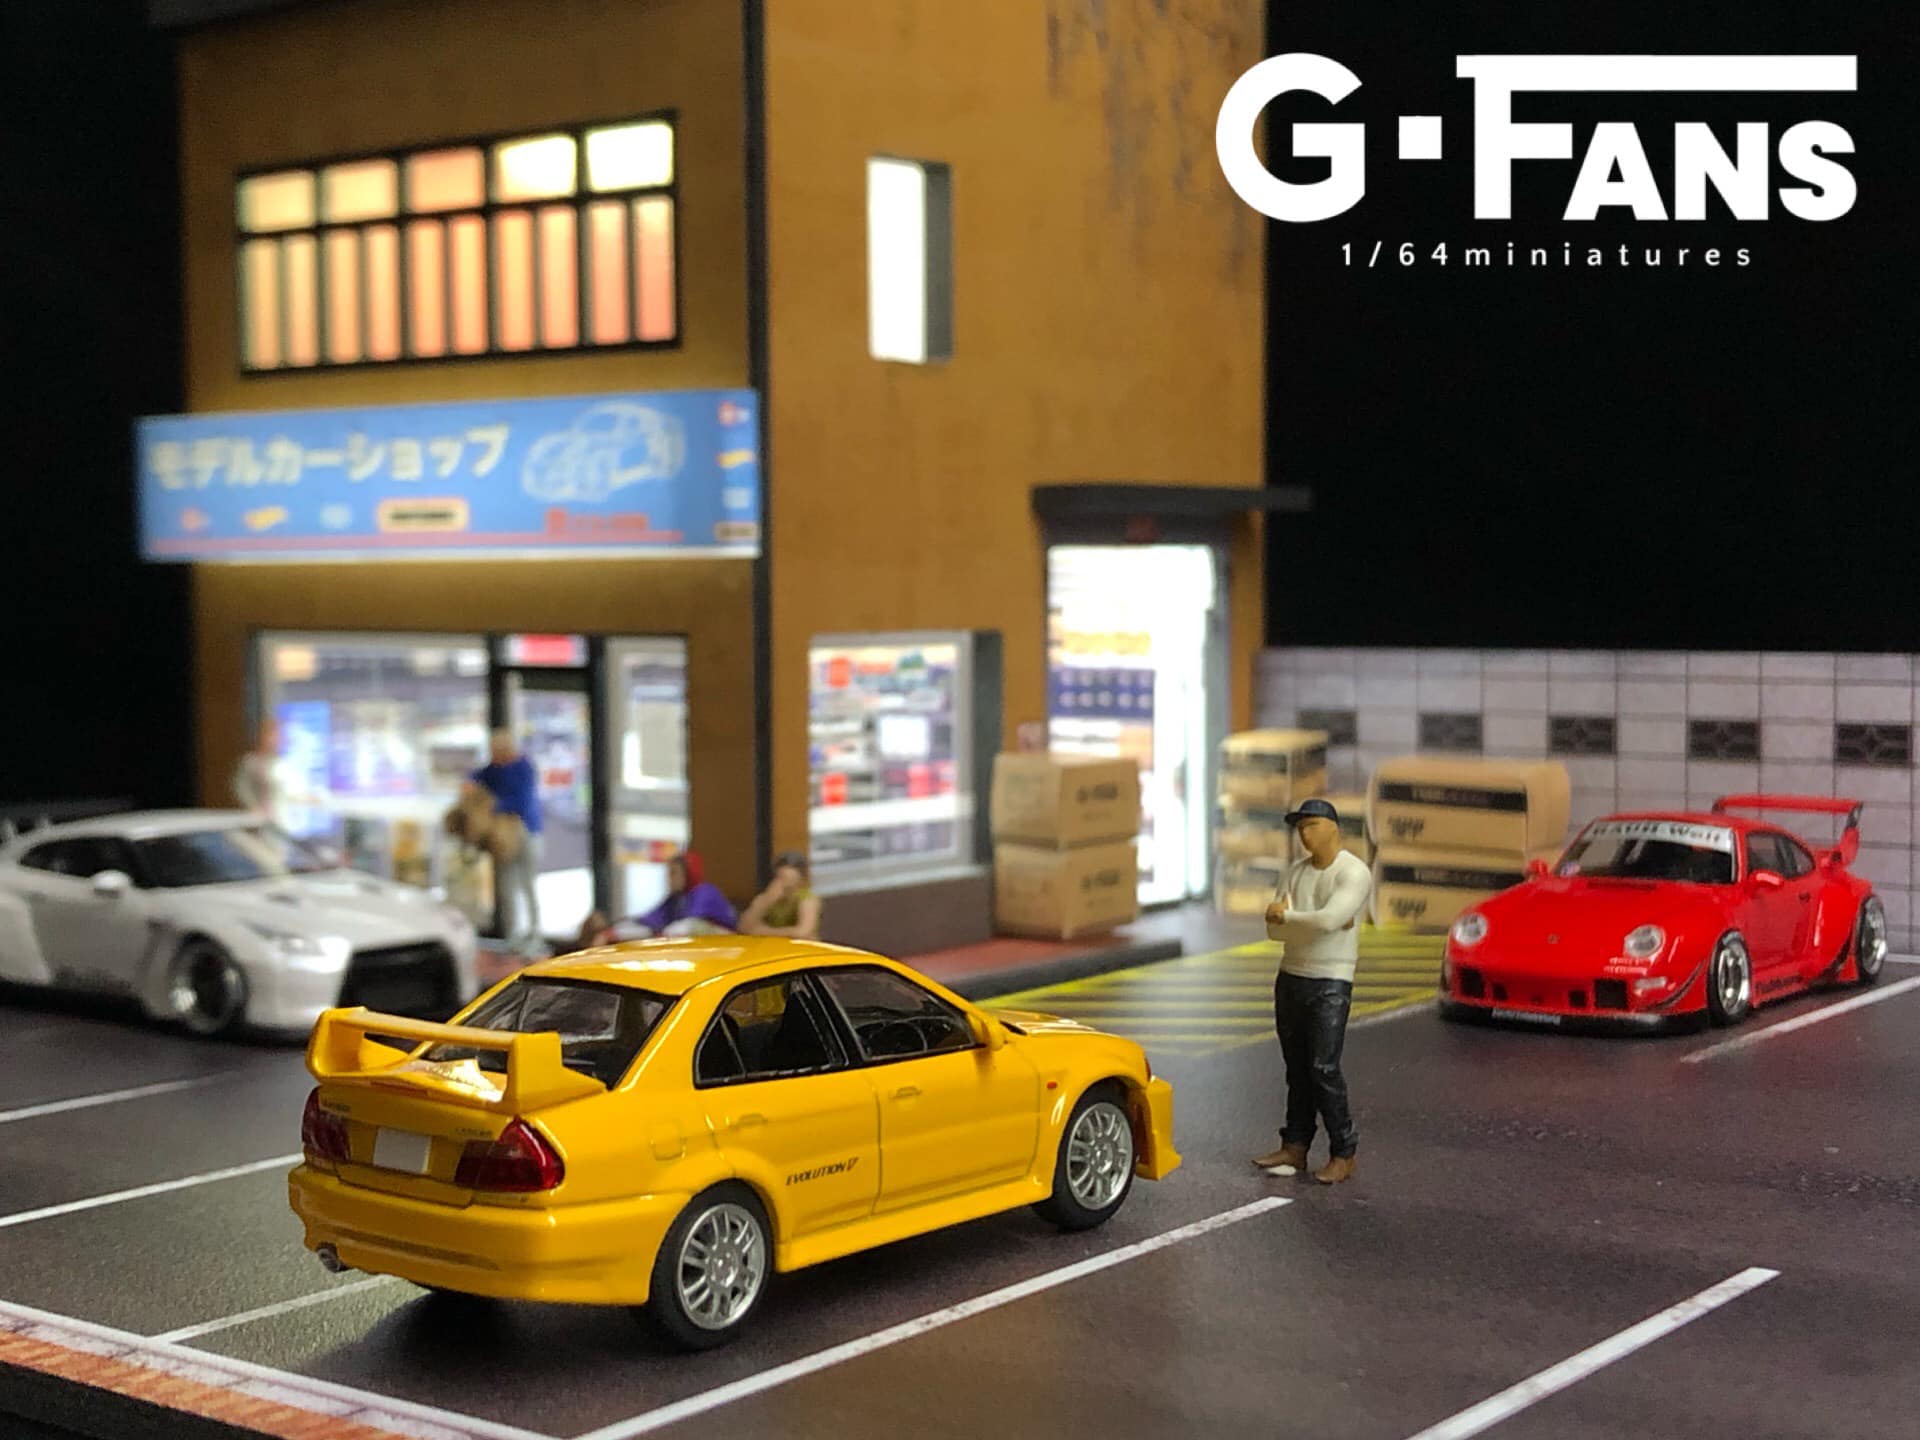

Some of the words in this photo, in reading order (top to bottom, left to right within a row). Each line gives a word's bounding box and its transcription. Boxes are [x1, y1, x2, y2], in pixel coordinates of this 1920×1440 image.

[150, 424, 509, 489] モデルカーショップ
[785, 1161, 847, 1186] EVOLUTION
